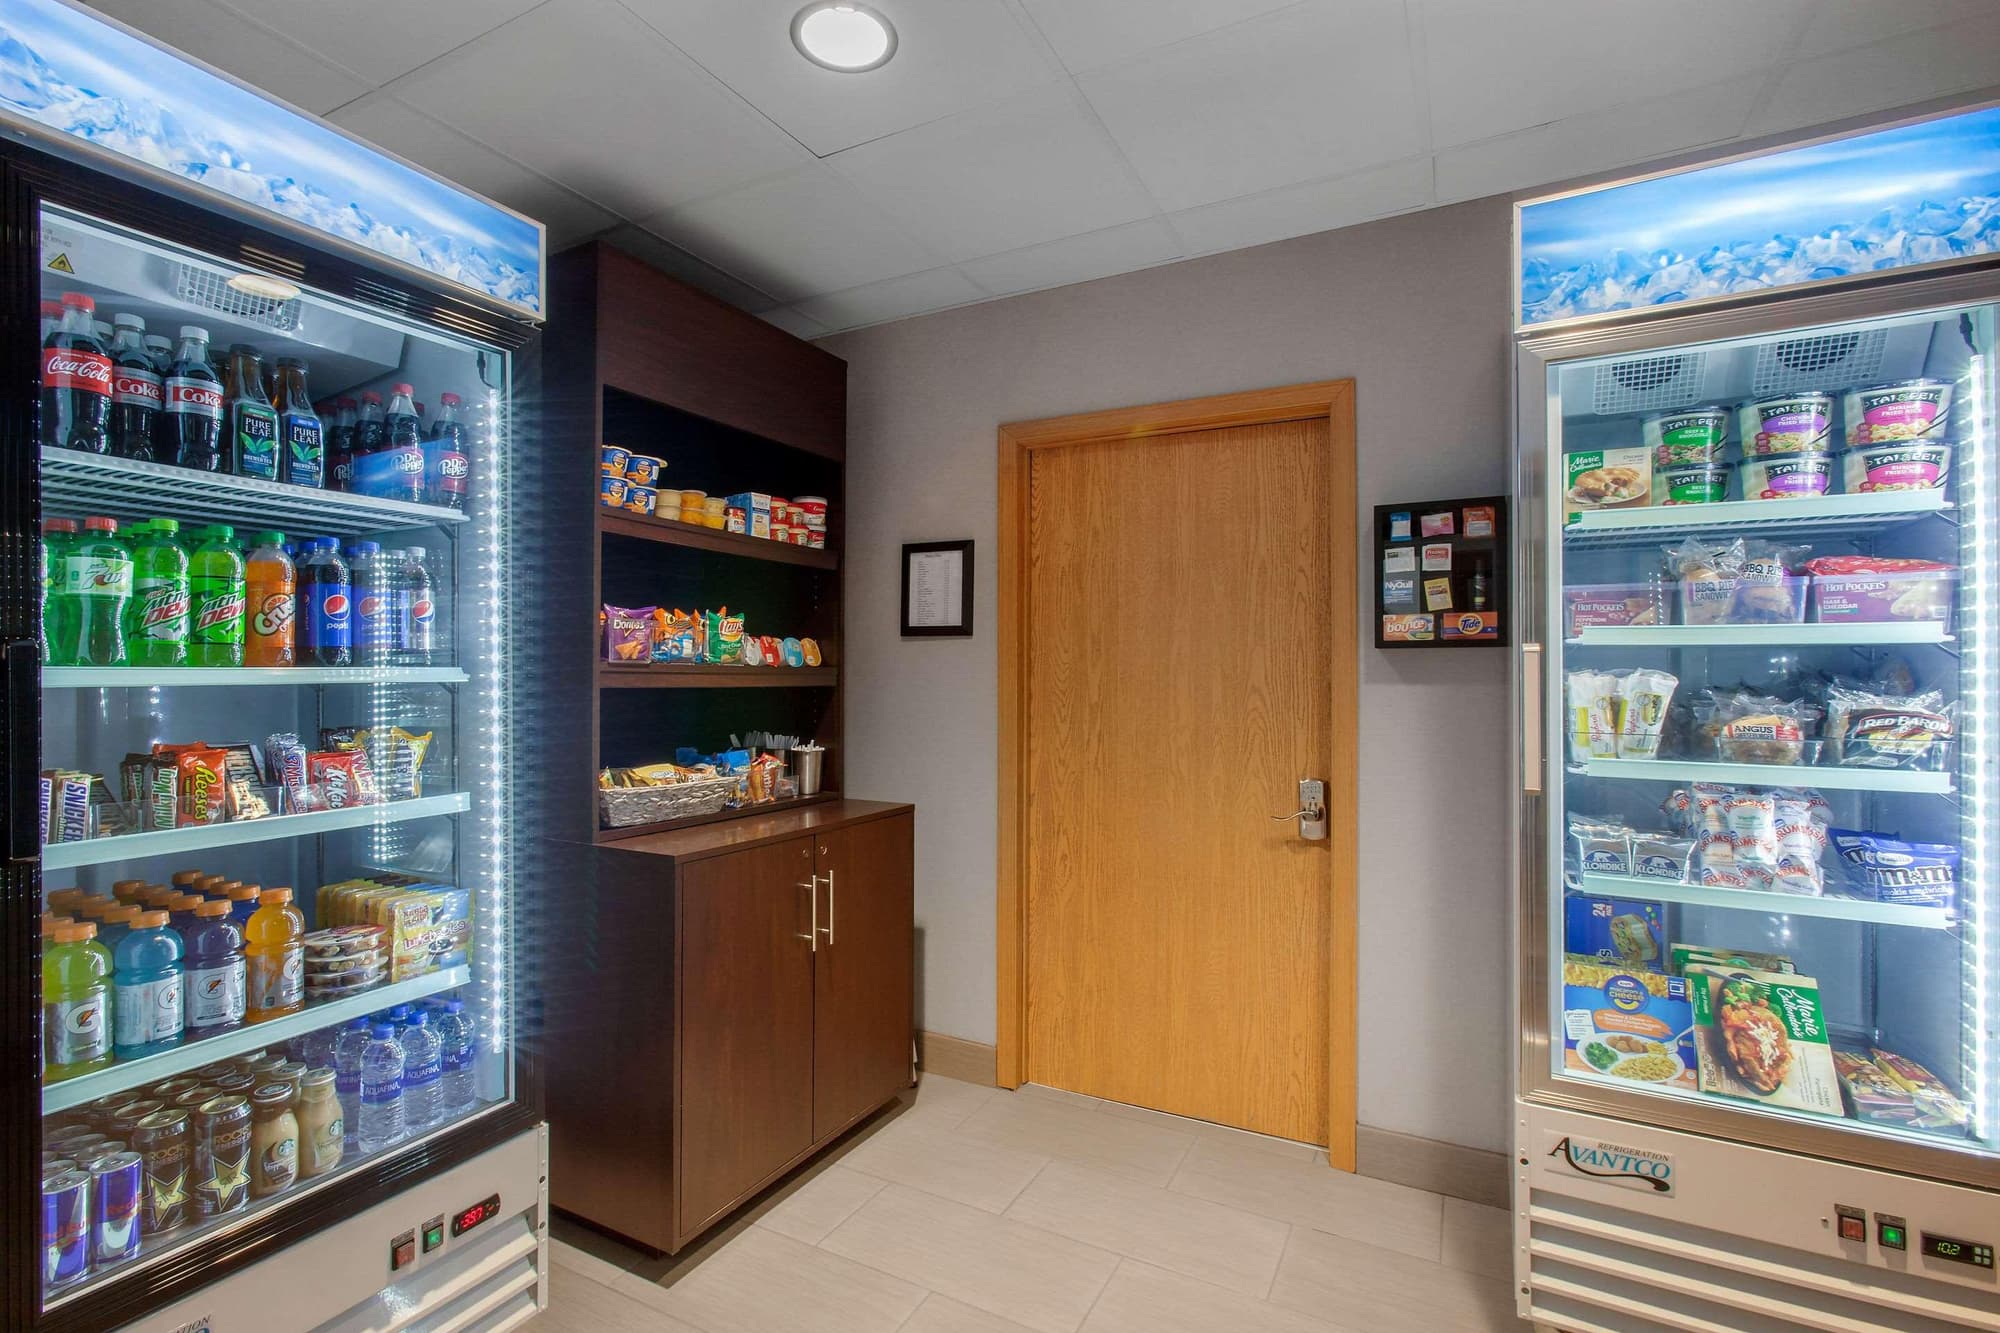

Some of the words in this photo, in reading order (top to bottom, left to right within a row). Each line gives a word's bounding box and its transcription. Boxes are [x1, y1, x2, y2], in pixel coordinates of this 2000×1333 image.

[47, 356, 110, 383] Coca-Cola
[116, 378, 159, 399] Coke
[179, 388, 220, 406] Coke
[1870, 394, 1895, 405] TAI
[1908, 392, 1935, 400] PEI
[1767, 406, 1790, 416] TAI
[245, 417, 271, 430] PURE
[1667, 419, 1688, 430] TAI
[1697, 418, 1718, 426] PEI
[245, 426, 273, 438] LEAF
[293, 426, 318, 437] PURE
[293, 434, 319, 446] LEAF
[404, 452, 417, 463] Dr
[451, 458, 464, 468] Dr
[1873, 454, 1897, 465] TAI
[1912, 452, 1935, 461] PEI
[439, 459, 467, 475] Pepper
[1774, 464, 1797, 474] TAI
[1674, 476, 1695, 486] TAI
[1384, 580, 1414, 591] NyQuil
[1695, 582, 1716, 593] BBQ
[1462, 618, 1481, 631] Tide
[1735, 725, 1774, 734] ANGUS
[1863, 717, 1897, 729] RED
[1897, 715, 1950, 733] BARON
[64, 781, 88, 842] SNICKER
[1583, 861, 1627, 872] KLONDIKE
[1634, 863, 1684, 880] KLONDIKE
[1789, 988, 1819, 1037] Marie
[407, 1063, 440, 1079] AQUAFINA
[364, 1080, 401, 1096] AQUAFINA
[1598, 1142, 1671, 1161] REFRIGERATION
[1547, 1136, 1672, 1182] AVANTCO
